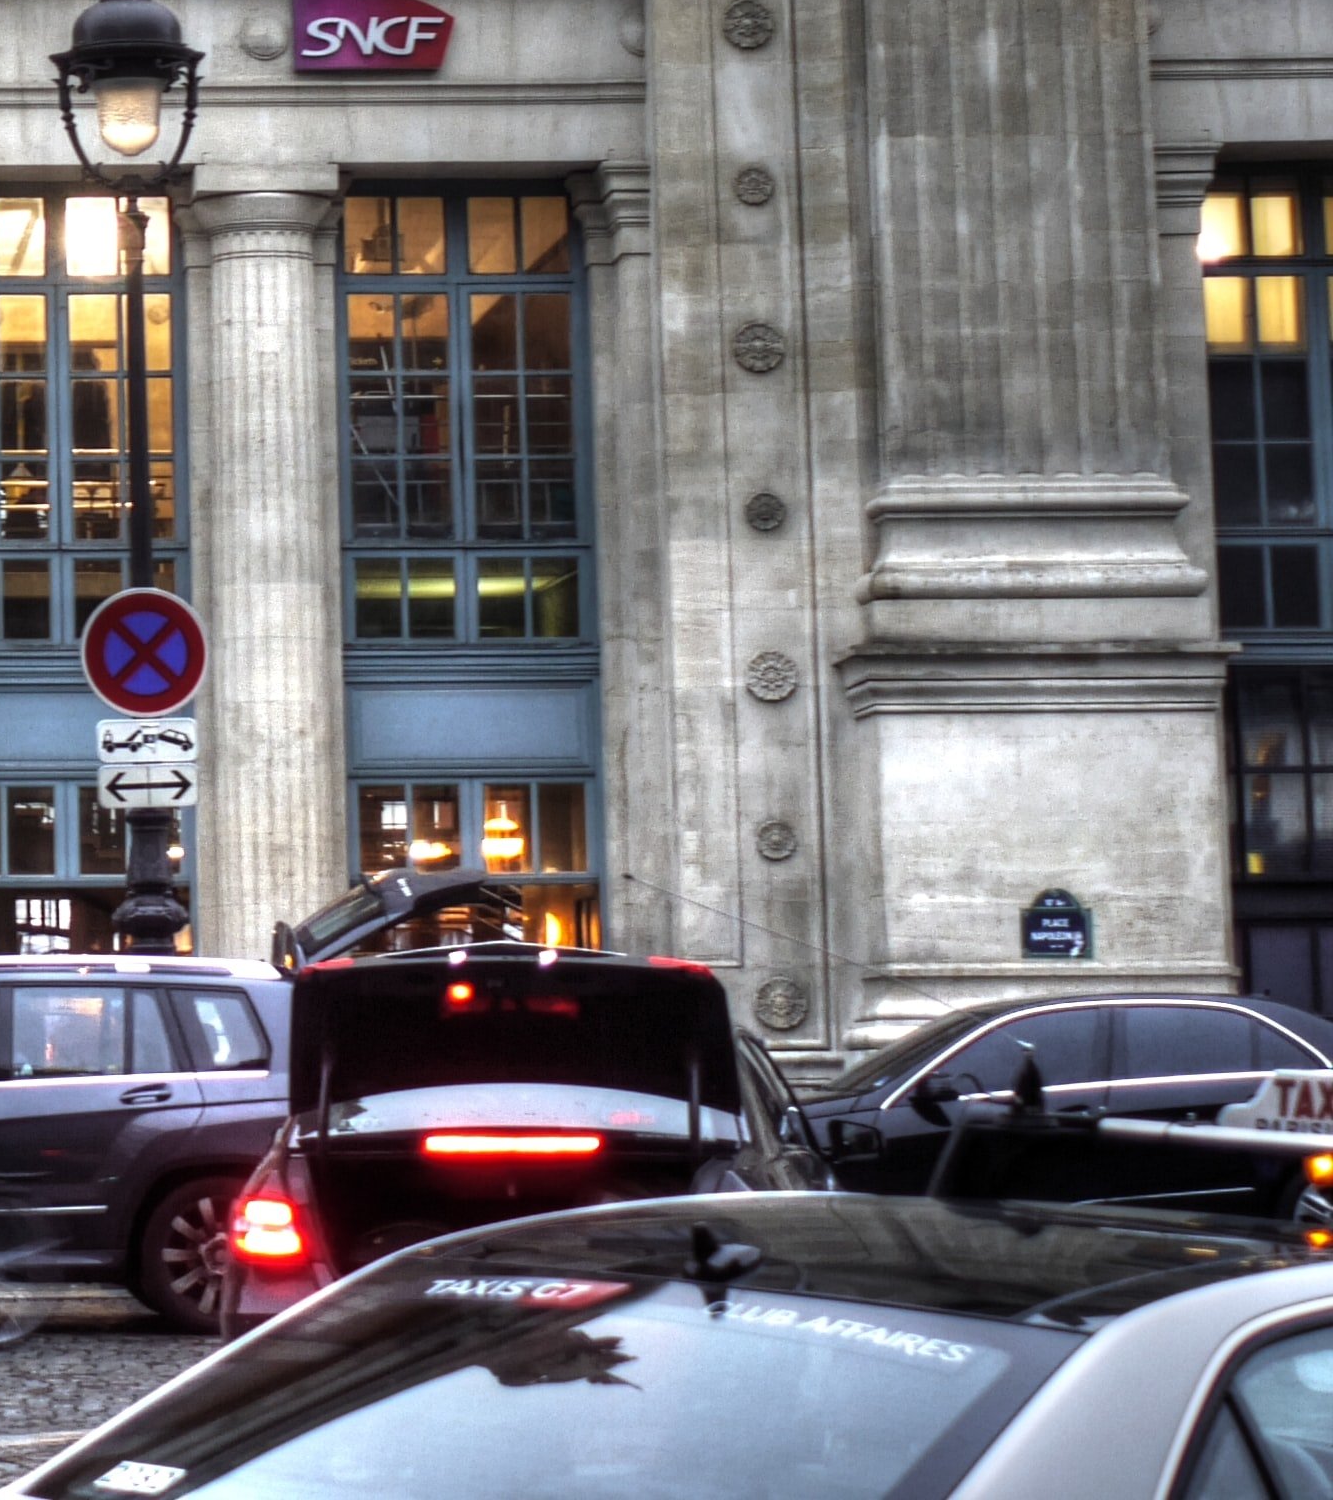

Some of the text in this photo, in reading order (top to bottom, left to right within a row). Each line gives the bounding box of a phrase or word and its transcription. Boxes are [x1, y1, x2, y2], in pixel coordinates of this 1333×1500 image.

[300, 15, 446, 58] SNCF
[424, 1279, 594, 1299] TAXIS G7
[705, 1299, 975, 1364] CLUB AFFAIRES
